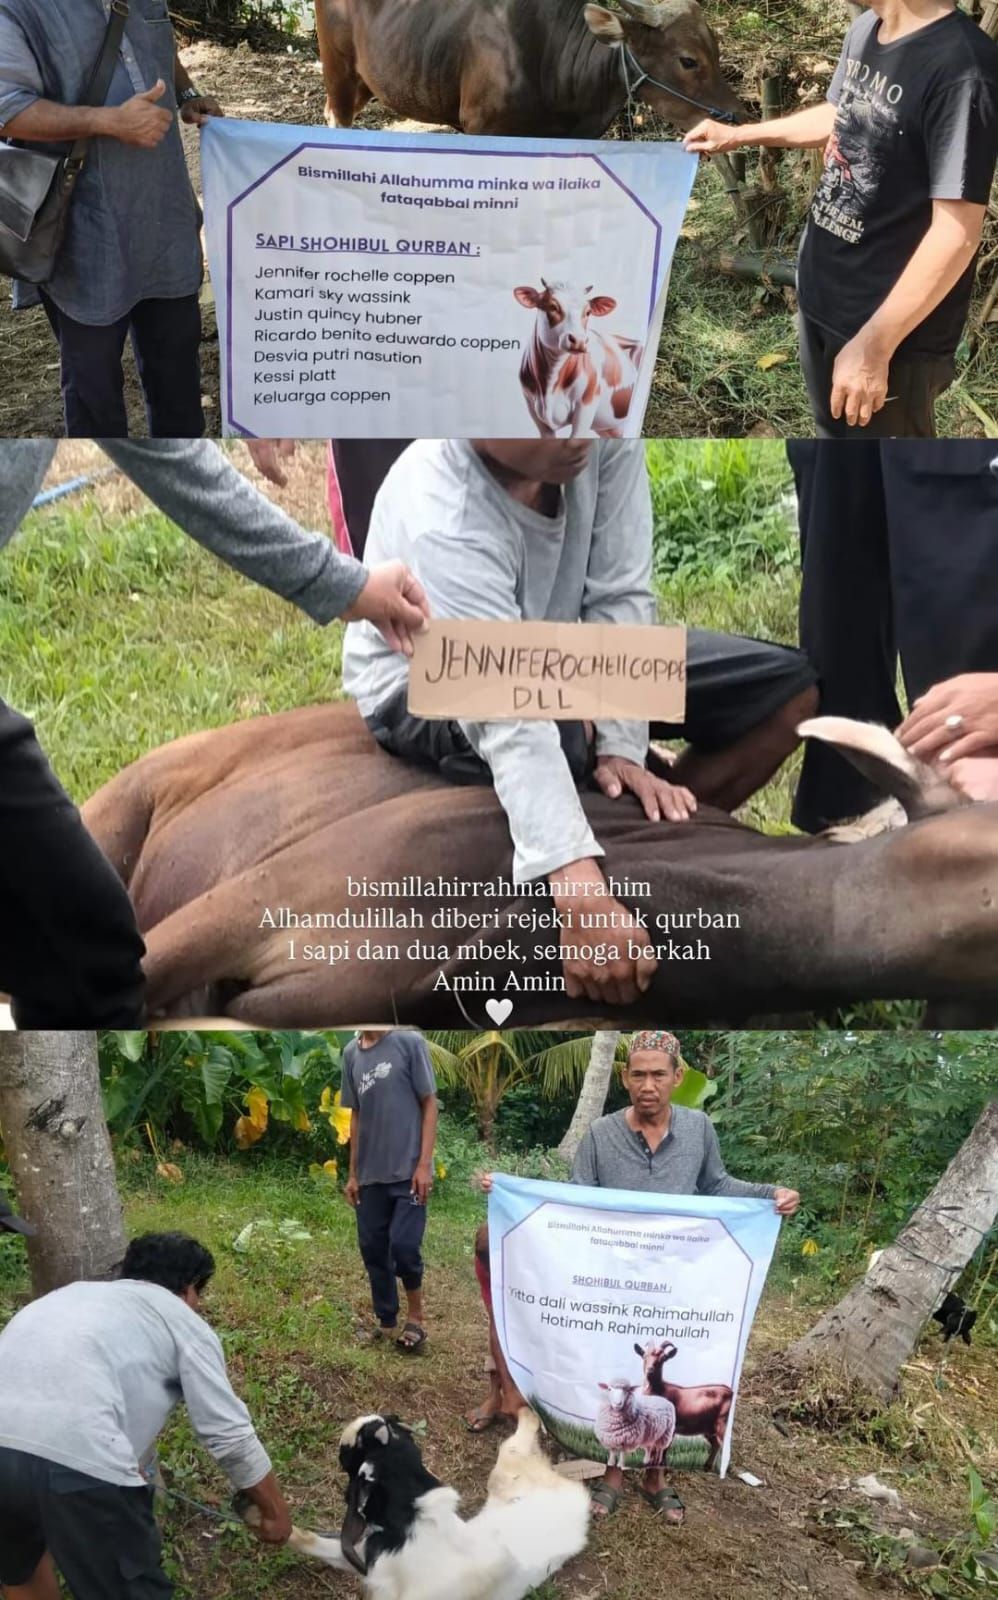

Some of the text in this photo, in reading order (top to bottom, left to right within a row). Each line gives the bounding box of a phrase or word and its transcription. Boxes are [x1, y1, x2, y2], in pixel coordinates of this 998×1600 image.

[297, 166, 600, 191] Bismillahi Allahumma minka wa ilaika
[381, 192, 518, 209] fataqabbal minni
[255, 233, 294, 249] SAPI
[300, 236, 390, 253] SHOHIBUL
[396, 239, 471, 255] QURBAN
[255, 266, 455, 286] Jennifer rochelle coppen
[255, 286, 411, 304] Kamari sky wassink
[254, 307, 423, 325] Justin quincy hubner
[254, 328, 521, 352] Ricardo benito eduwardo coppen
[254, 348, 422, 365] Desvia putri nasution
[254, 368, 336, 384] Kessi platt
[254, 390, 391, 405] Keluarga coppen
[513, 686, 572, 710] DLL
[572, 1275, 621, 1289] SHOHIBUL
[624, 1279, 667, 1292] QURBAN
[539, 1296, 567, 1310] dali
[570, 1301, 629, 1317] wassink
[632, 1305, 735, 1323] Rahimahullah
[540, 1312, 710, 1339] Hotimah Rahimahullah
